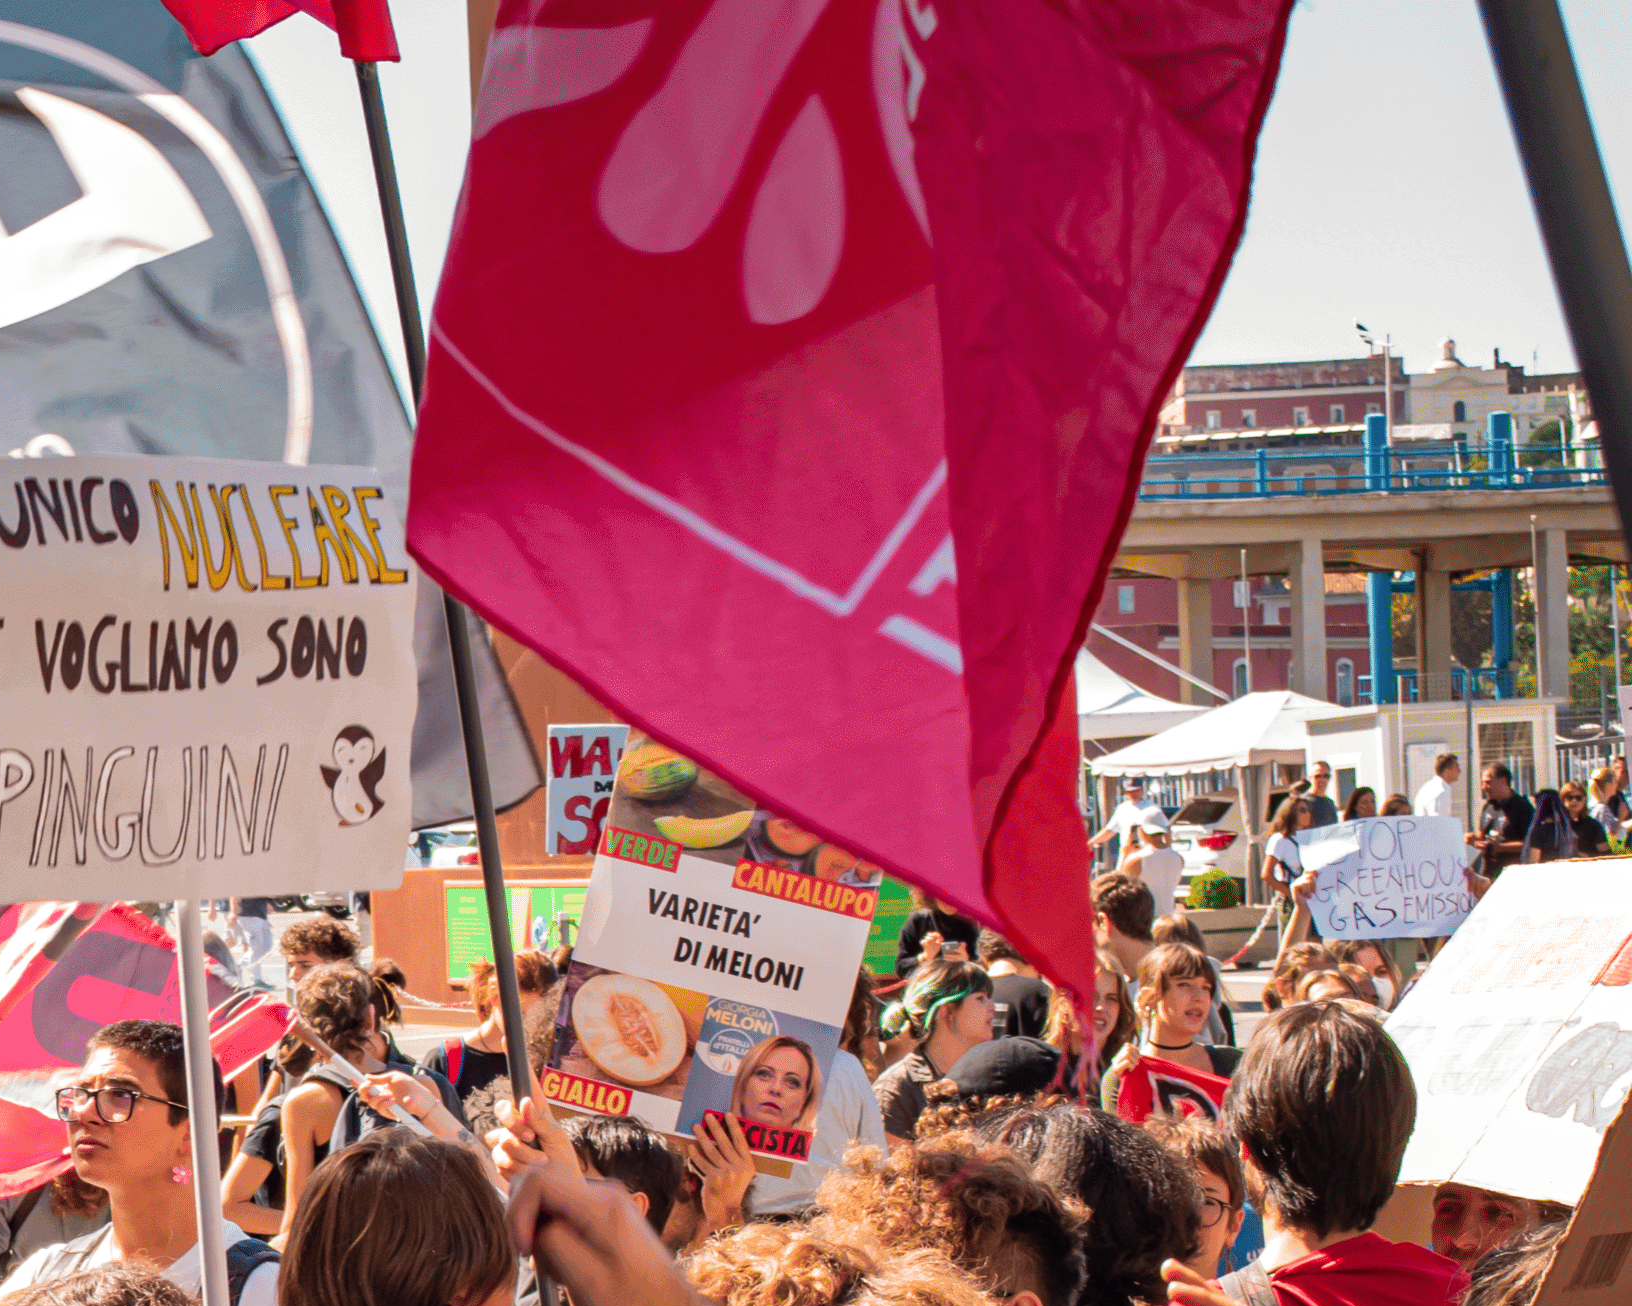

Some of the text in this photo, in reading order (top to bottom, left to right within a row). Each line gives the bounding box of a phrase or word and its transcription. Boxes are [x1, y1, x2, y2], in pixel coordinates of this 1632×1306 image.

[149, 479, 409, 592] NUCLEARE
[35, 615, 239, 694] VOGLIAMO
[257, 615, 368, 686] SONO
[606, 829, 679, 868] VERDE
[648, 888, 761, 939] VARIETA'
[733, 863, 874, 918] CANTALUPO
[1329, 897, 1397, 932] GAS
[673, 936, 805, 991] DI MELONI
[706, 1007, 773, 1036] MELONI
[718, 1000, 767, 1019] GIORGIA
[542, 1072, 626, 1115] GIALLO
